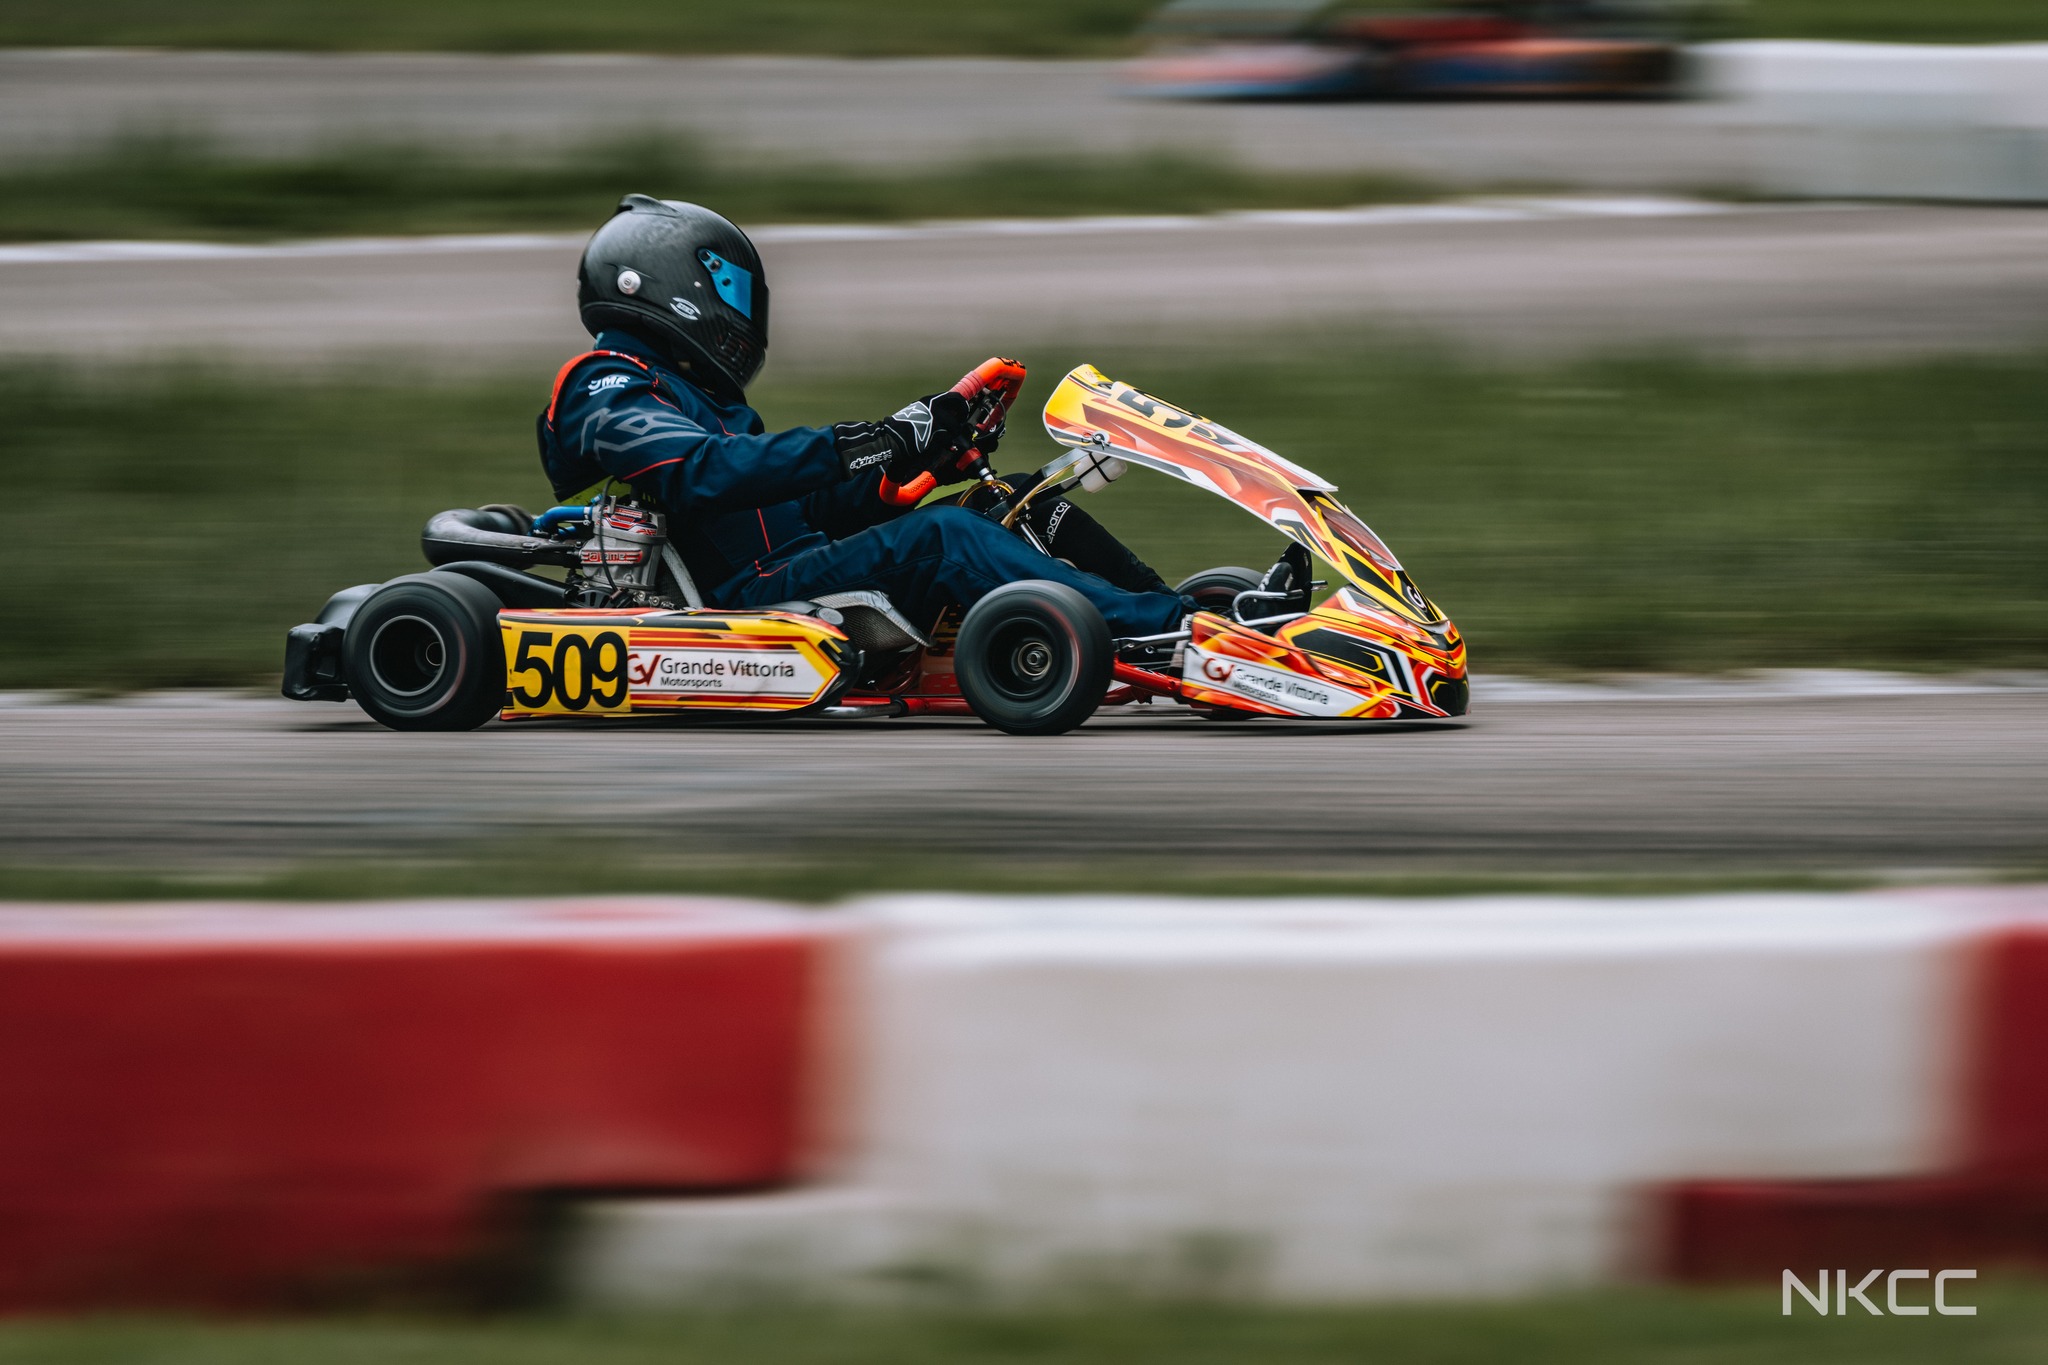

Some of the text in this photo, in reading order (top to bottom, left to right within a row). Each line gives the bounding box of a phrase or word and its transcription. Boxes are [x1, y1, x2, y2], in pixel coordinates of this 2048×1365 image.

[512, 631, 628, 711] 509
[660, 657, 794, 678] Grande Vittoria
[660, 677, 723, 688] Motorsports
[1234, 668, 1283, 692] Grande
